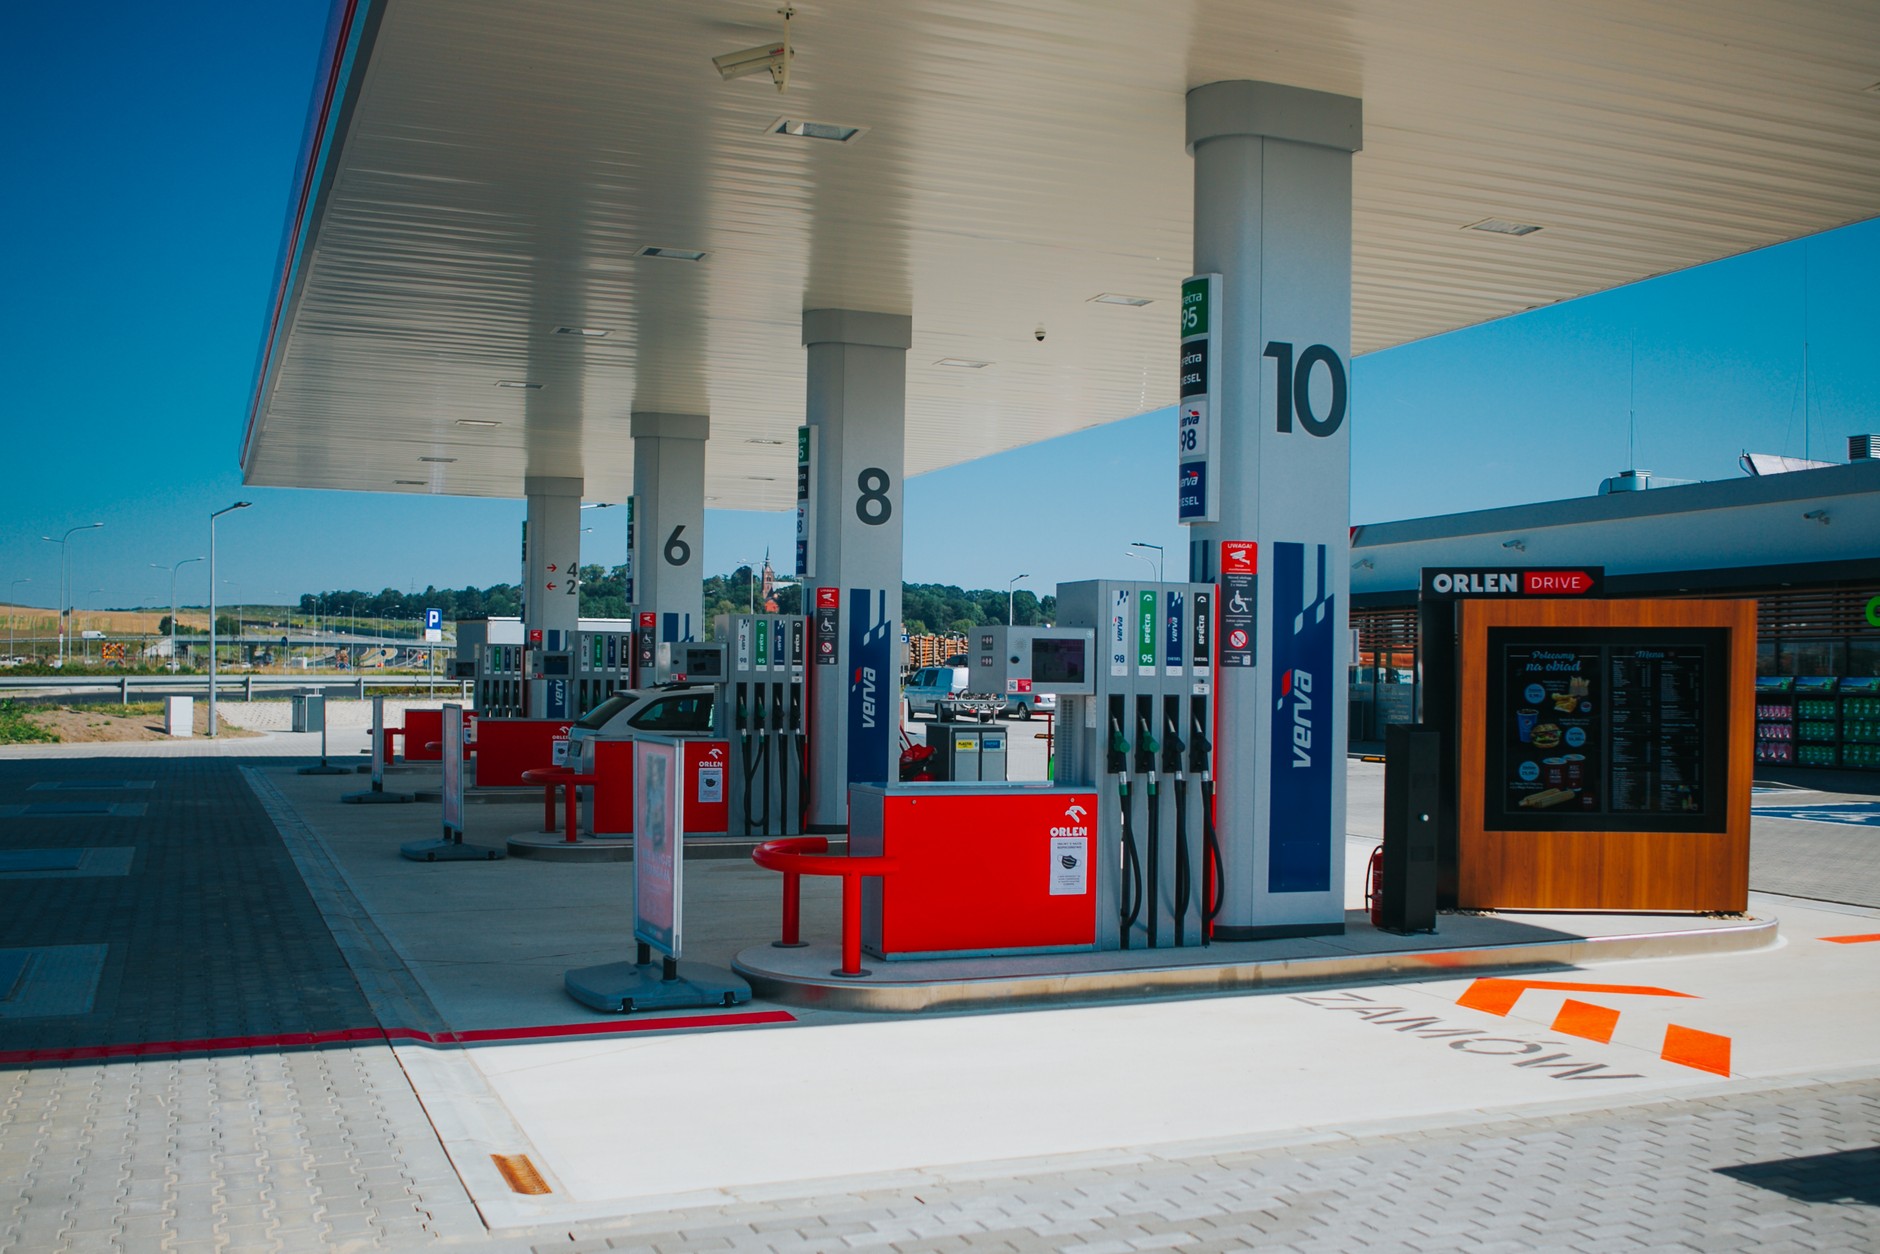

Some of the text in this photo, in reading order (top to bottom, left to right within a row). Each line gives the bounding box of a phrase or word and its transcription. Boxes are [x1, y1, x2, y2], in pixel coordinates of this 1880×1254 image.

[1182, 306, 1198, 331] 95
[1263, 340, 1347, 438] 10
[1181, 428, 1197, 452] 98
[855, 467, 893, 526] 8
[663, 524, 691, 566] 6
[566, 562, 578, 578] 4
[566, 579, 577, 595] 2
[1432, 573, 1581, 593] ORLEN DRIVE
[428, 610, 439, 628] P
[1113, 654, 1125, 663] 98
[1141, 654, 1153, 663] 95
[1531, 650, 1575, 661] Polecamy
[1526, 660, 1581, 672] na obiad
[862, 666, 876, 728] verva
[1292, 669, 1312, 768] verva
[1050, 826, 1088, 837] ORLEN
